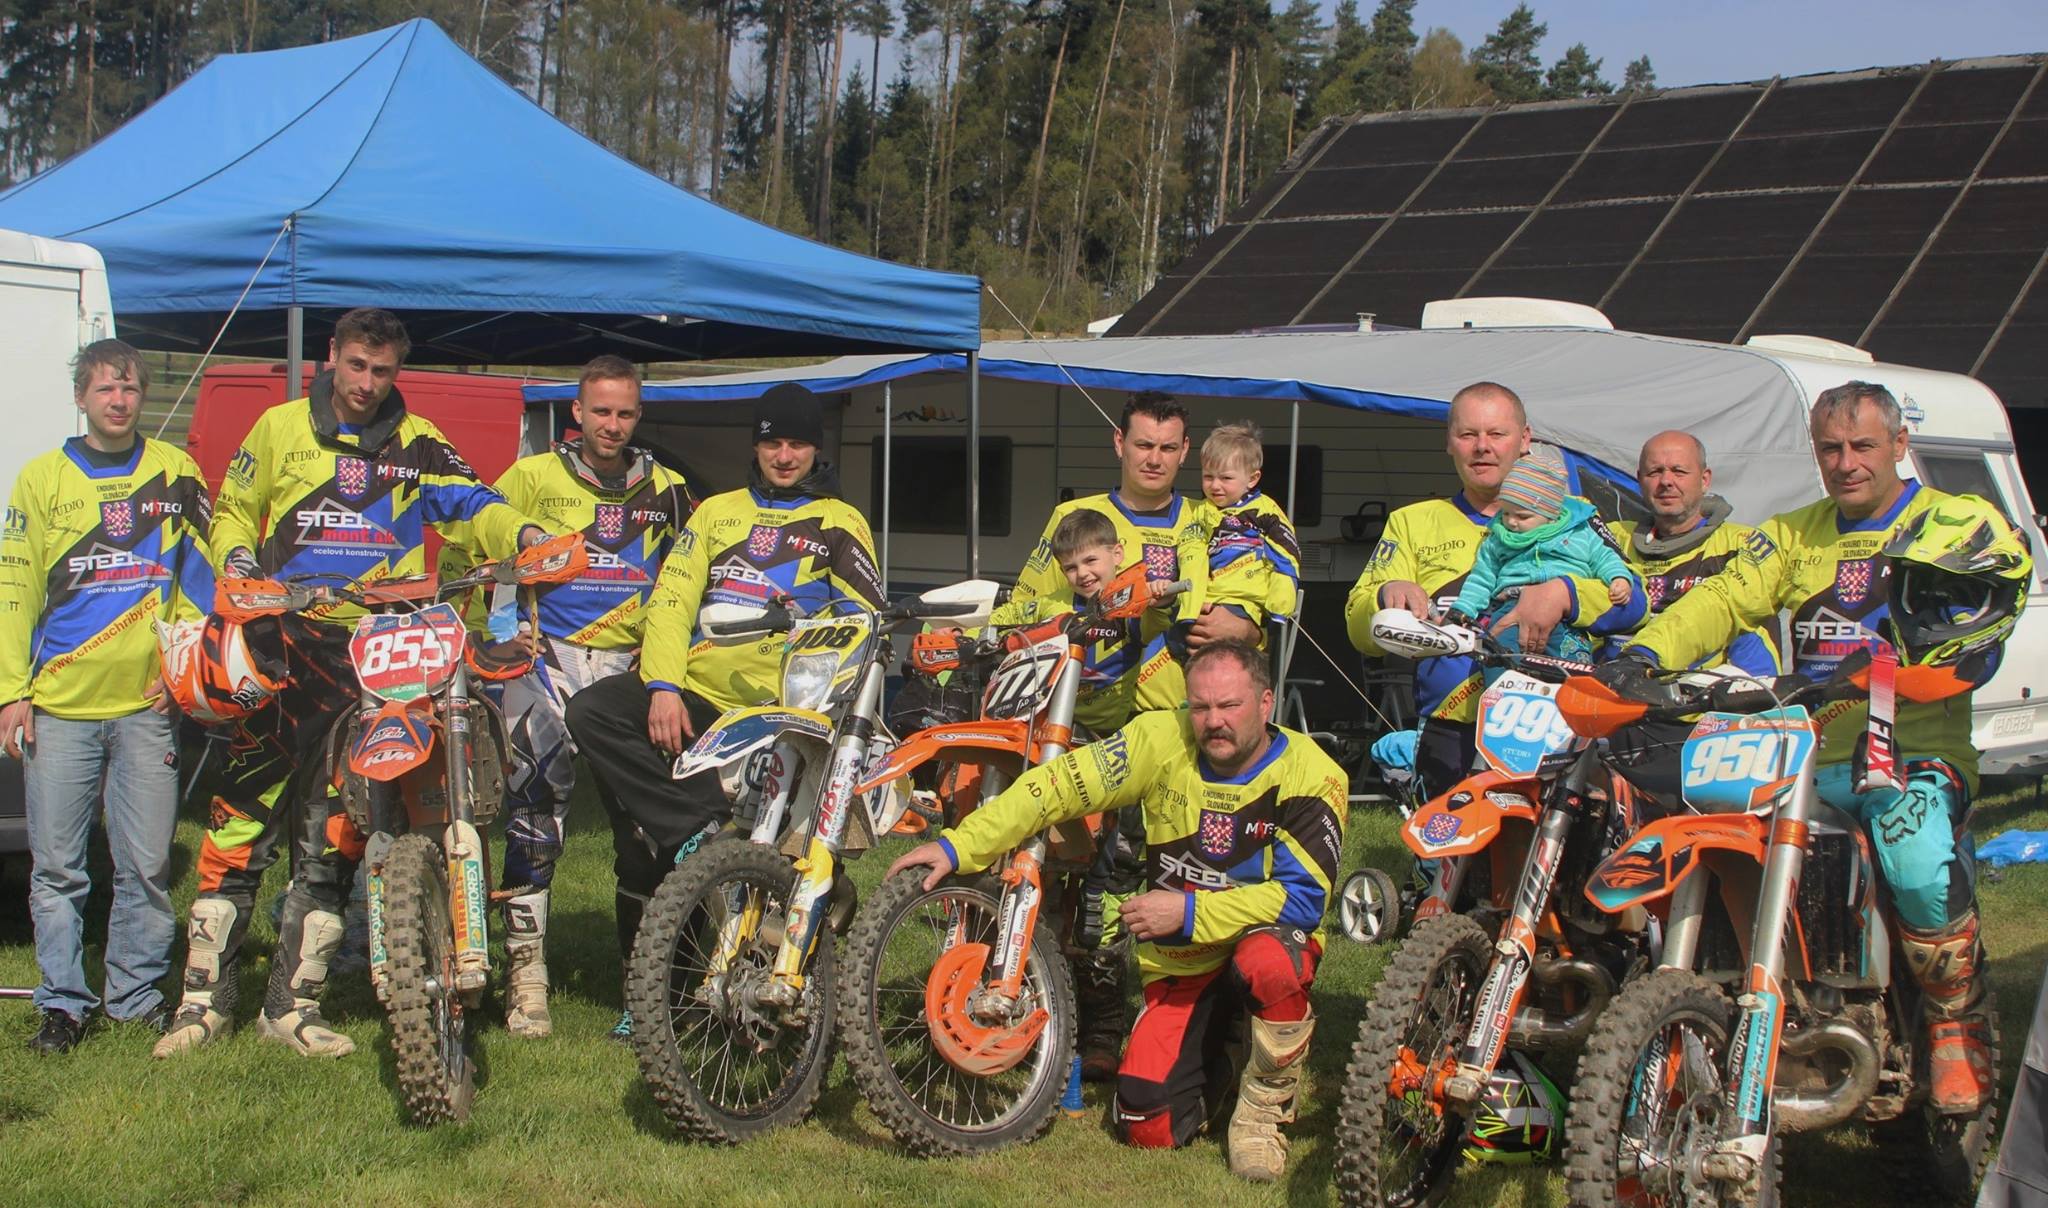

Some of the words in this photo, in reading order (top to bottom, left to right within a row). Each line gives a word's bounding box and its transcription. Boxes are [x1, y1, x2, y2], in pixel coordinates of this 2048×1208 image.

[538, 498, 581, 509] STUDIO
[296, 510, 371, 529] STEEL
[69, 551, 142, 572] STEEL
[711, 565, 770, 587] STEEL
[47, 596, 159, 674] www.chatachriby.cz
[1378, 629, 1448, 651] ACERBIS
[1795, 622, 1873, 641] STEEL
[361, 626, 456, 677] 855
[363, 748, 415, 769] KTM
[1685, 733, 1799, 787] 950
[1867, 714, 1895, 780] FOX
[1226, 792, 1241, 801] TEAM
[1159, 853, 1229, 888] STEEL
[466, 865, 482, 928] MOTOREX
[370, 894, 385, 959] MOTOREX
[1483, 1029, 1500, 1062] STAVBY
